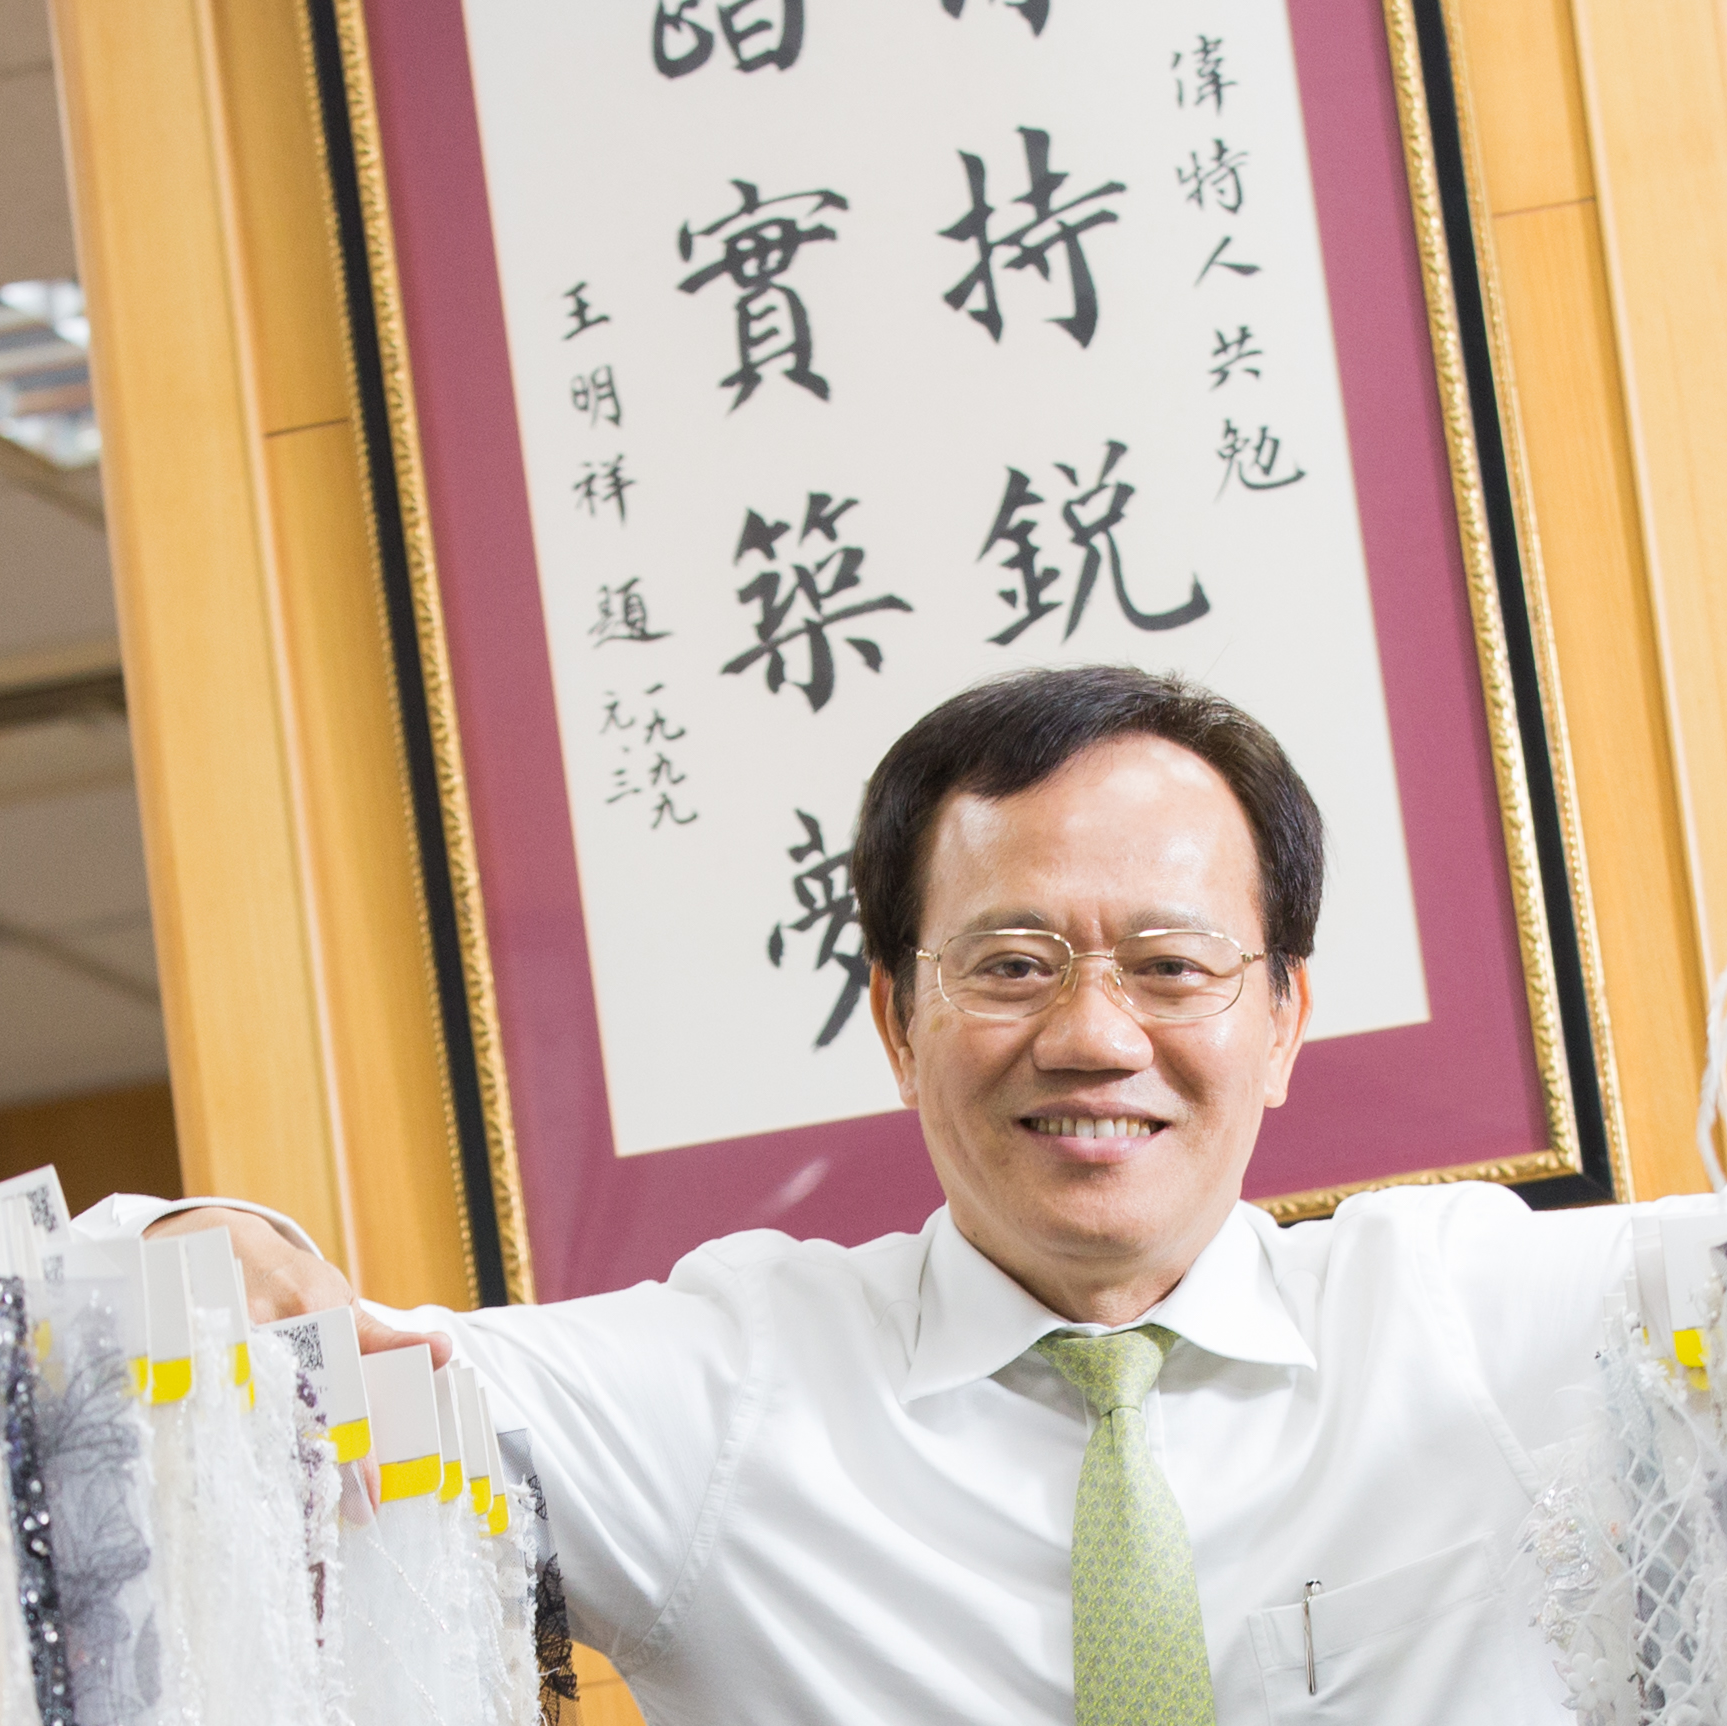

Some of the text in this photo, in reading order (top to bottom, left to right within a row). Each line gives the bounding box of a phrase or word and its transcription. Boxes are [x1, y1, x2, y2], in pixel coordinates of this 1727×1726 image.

[1171, 34, 1307, 503] 偉特人共勉
